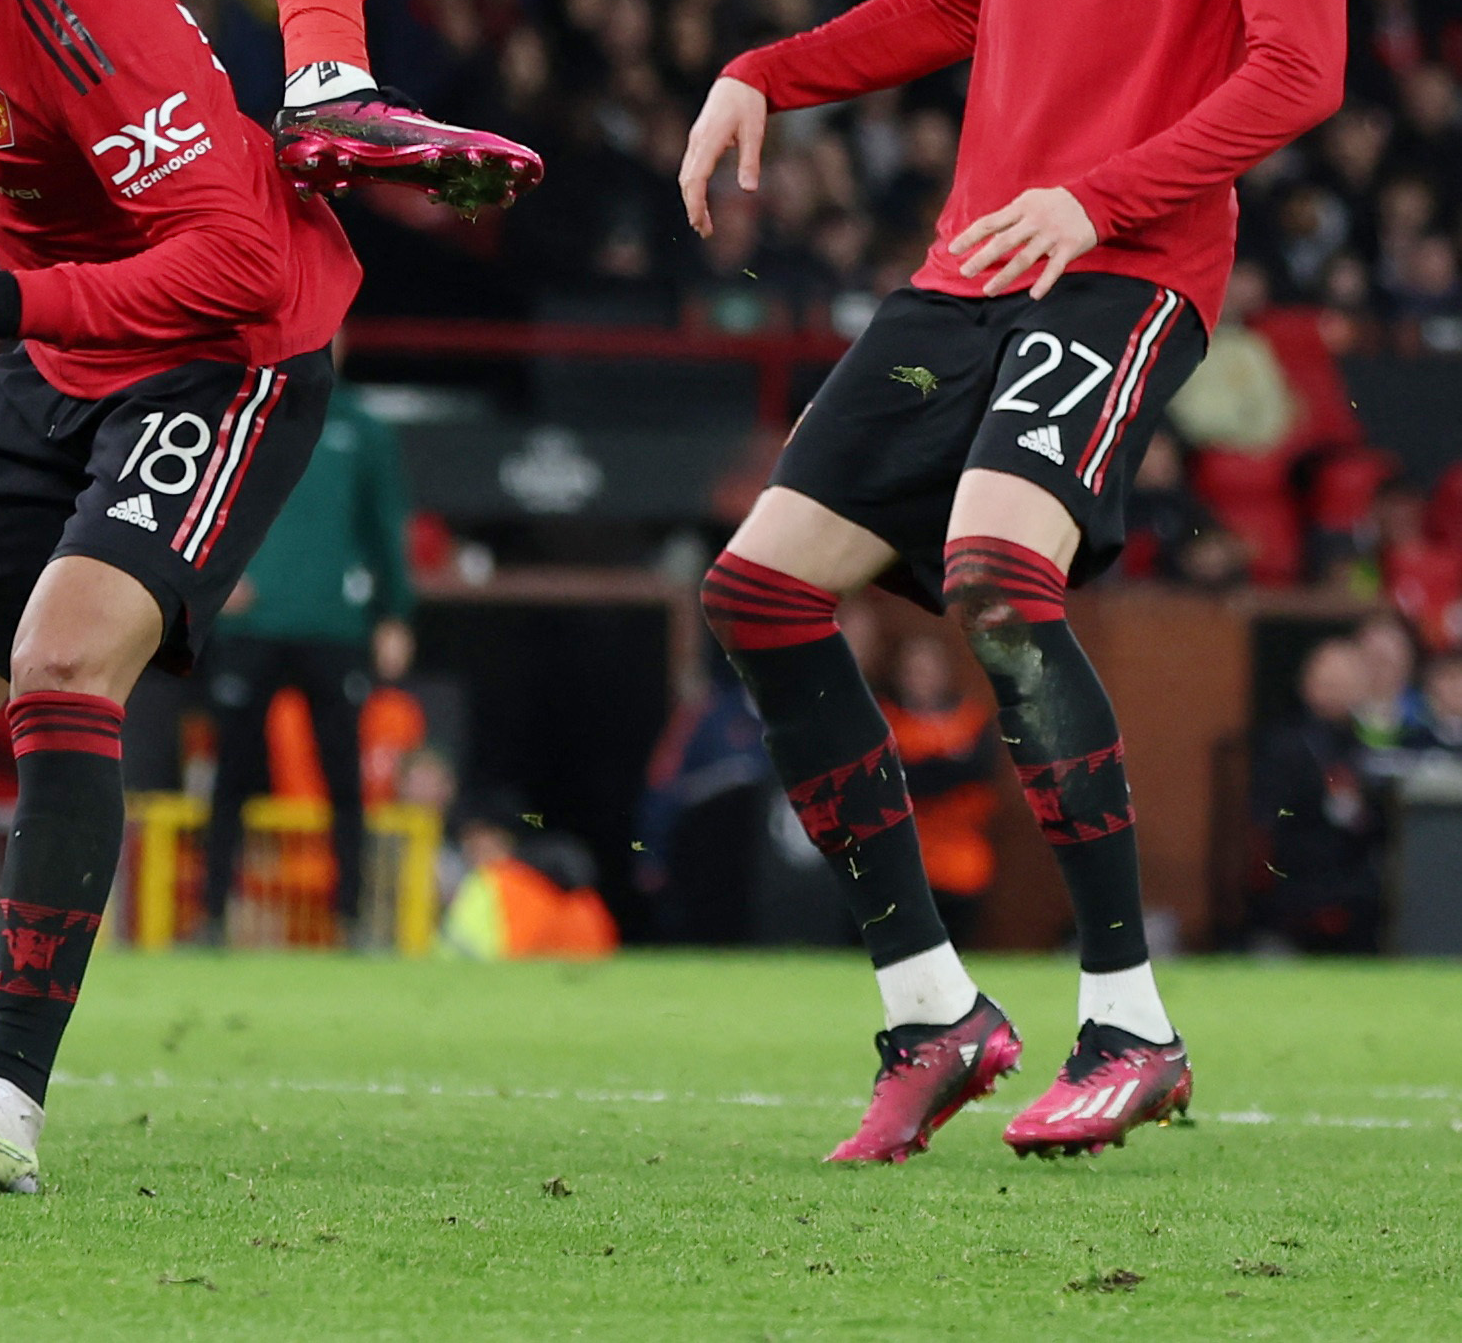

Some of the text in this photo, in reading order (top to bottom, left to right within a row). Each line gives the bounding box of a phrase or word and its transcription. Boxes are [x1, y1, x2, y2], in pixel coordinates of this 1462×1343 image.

[91, 90, 206, 186] DXC
[120, 137, 213, 199] TECHNOLOGY
[991, 331, 1114, 419] 27
[117, 412, 212, 495] 18
[1017, 433, 1066, 466] adidas
[106, 505, 159, 533] adidas
